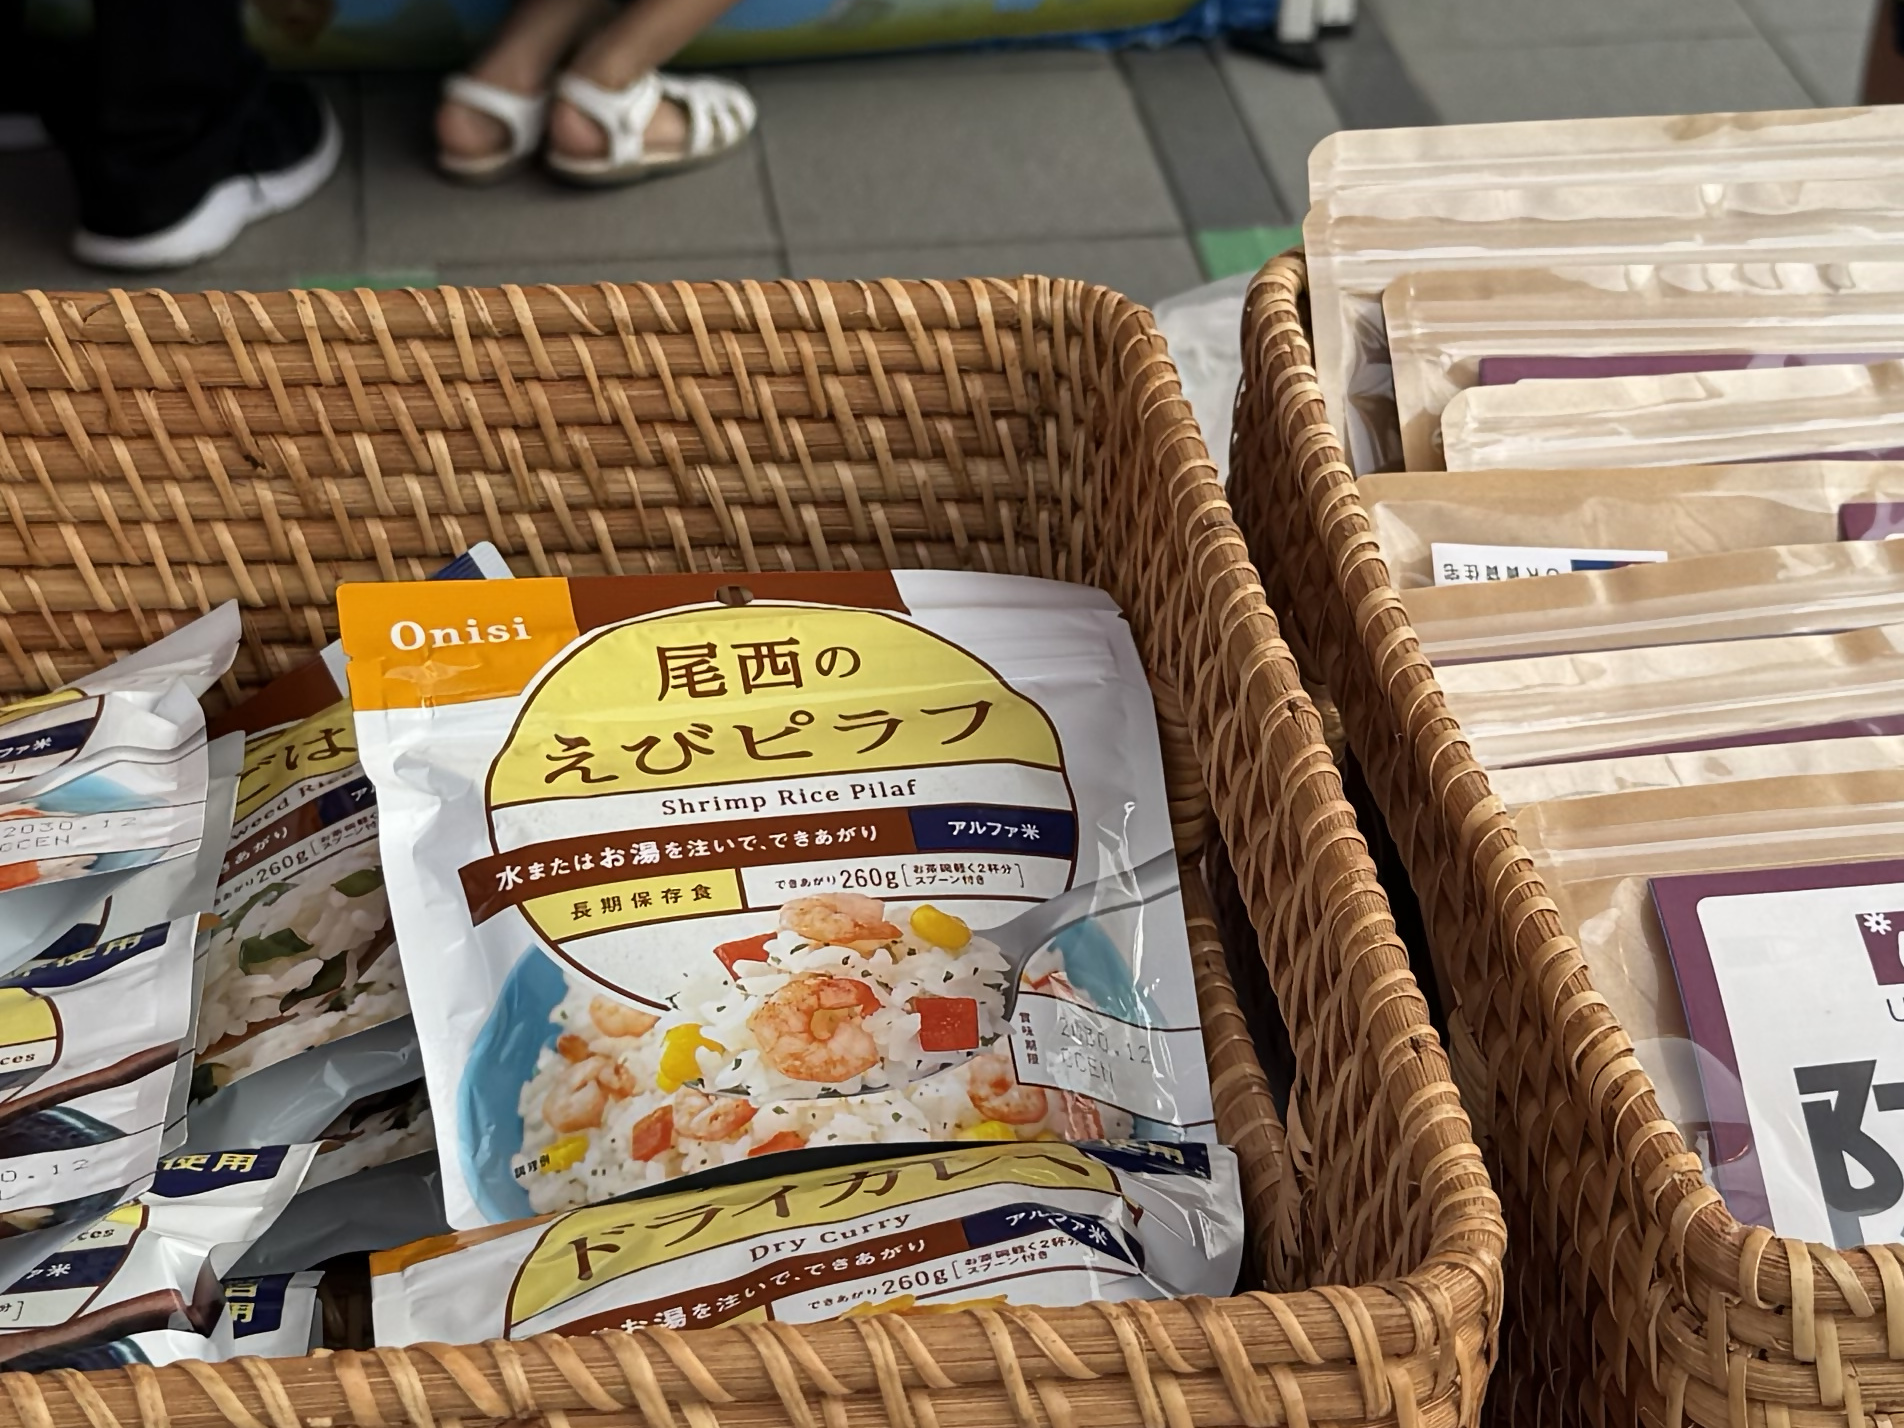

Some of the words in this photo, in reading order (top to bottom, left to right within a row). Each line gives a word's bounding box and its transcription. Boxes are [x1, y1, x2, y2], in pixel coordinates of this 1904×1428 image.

[390, 616, 532, 651] Onisi
[656, 636, 862, 702] 尾西の
[543, 699, 994, 785] えびピラフ
[661, 793, 767, 817] Shrimp
[778, 786, 841, 807] Rice
[850, 778, 917, 801] Pilaf
[947, 819, 1040, 841] アルファ米
[256, 849, 310, 884] 260g
[495, 824, 879, 892] 水またはお湯を注いで、できあがり
[839, 866, 900, 890] 260g
[570, 883, 713, 921] 長期保存食
[748, 1236, 807, 1264] Dry
[818, 1212, 912, 1245] Curry
[591, 1239, 926, 1334] お湯を注いで、できあがり
[881, 1265, 949, 1296] 260g
